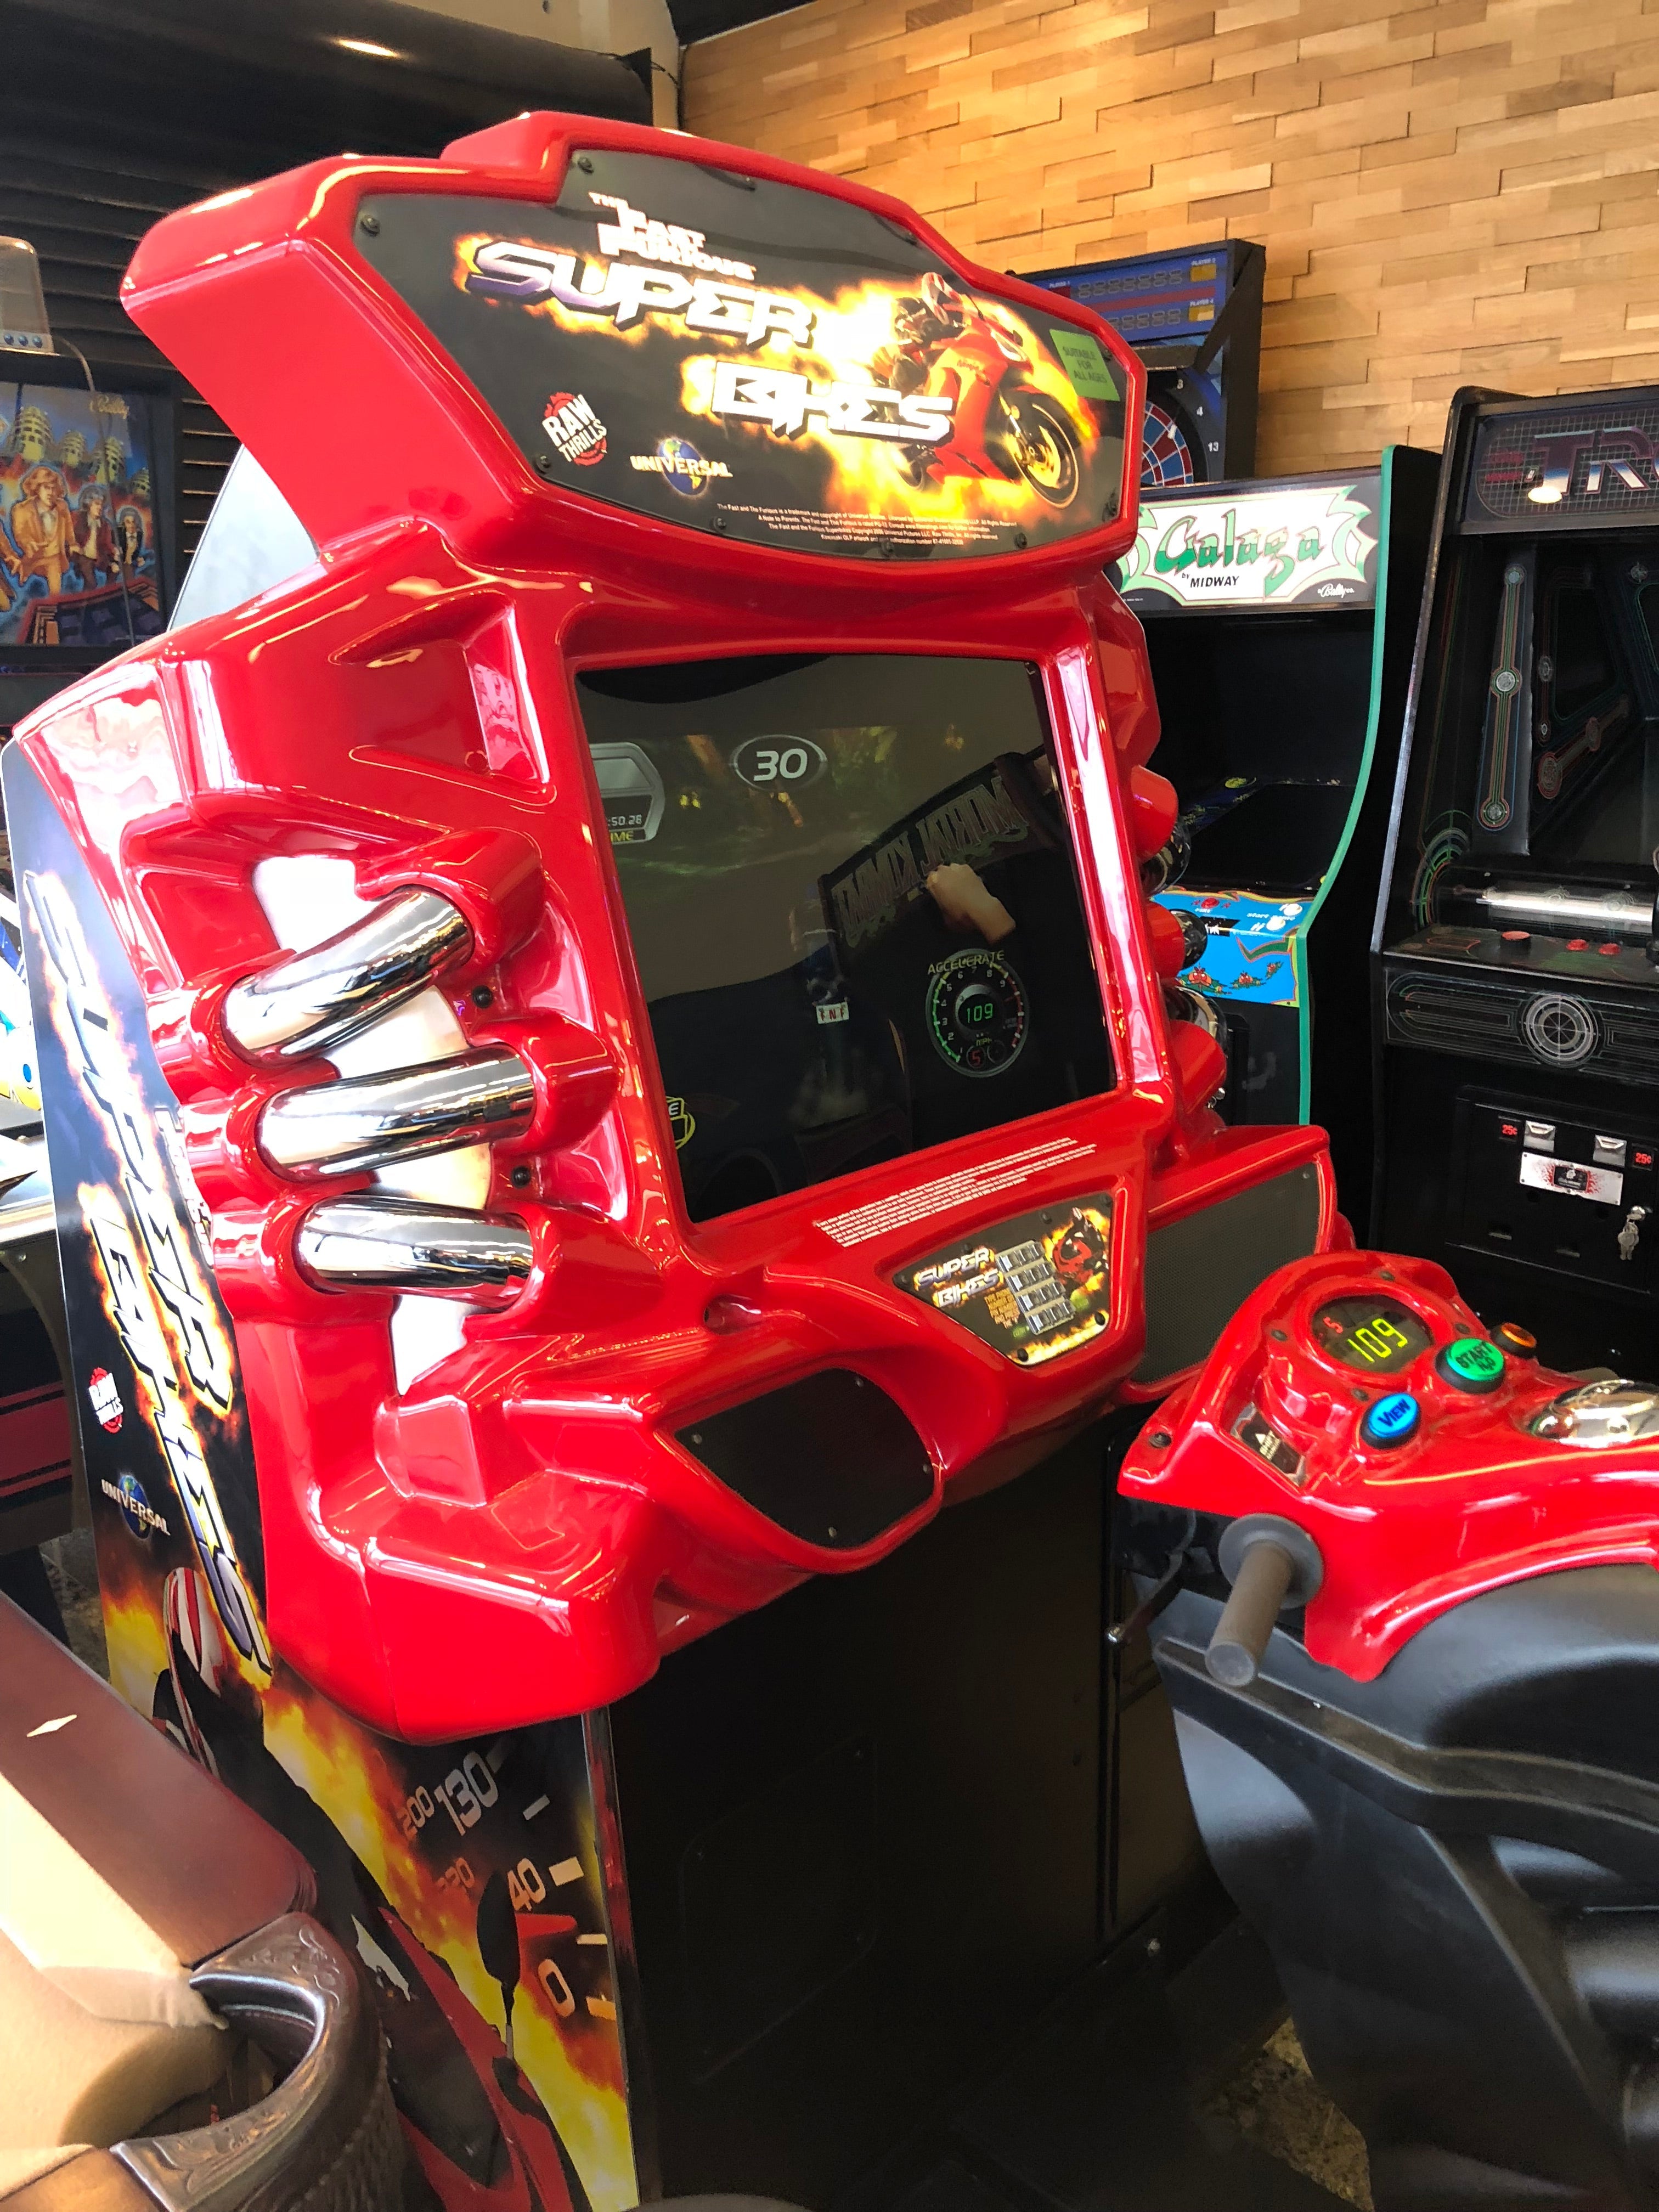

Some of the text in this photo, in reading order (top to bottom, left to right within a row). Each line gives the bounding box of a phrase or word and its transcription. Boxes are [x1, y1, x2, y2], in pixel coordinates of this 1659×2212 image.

[597, 222, 757, 281] FURIOUS
[465, 241, 817, 350] SUPER
[1063, 346, 1097, 360] SUITABLE
[1077, 359, 1093, 370] FOR
[1074, 370, 1108, 383] ALL AGES
[712, 361, 956, 447] BIKES
[1196, 406, 1204, 416] 4
[542, 394, 596, 447] RAW
[558, 419, 607, 462] THRILLS
[1207, 441, 1220, 452] 13
[630, 455, 733, 478] UNIVERSAL
[1533, 426, 1659, 495] TR
[1154, 508, 1327, 602] Galaga
[1190, 575, 1240, 588] MIDWAY
[753, 748, 808, 782] 30
[610, 831, 634, 843] IME
[928, 950, 1005, 975] ACCELERATE
[957, 971, 963, 979] 6
[946, 983, 952, 992] 5
[942, 1018, 948, 1026] 3
[967, 1003, 994, 1023] 109
[947, 1032, 954, 1041] 2
[1502, 1124, 1518, 1136] 25¢
[1635, 1152, 1652, 1165] 25¢
[917, 1248, 990, 1286] SUPER
[937, 1268, 1000, 1308] BIKES
[1347, 1318, 1408, 1363] 109
[1455, 1340, 1493, 1369] START
[88, 1373, 119, 1411] RAW
[1378, 1399, 1411, 1427] VIEW
[101, 1479, 171, 1536] UNIVERSAL
[434, 1751, 499, 1836] 130
[397, 1786, 435, 1840] 200
[507, 1858, 546, 1912] 40
[538, 1959, 575, 2018] 0
